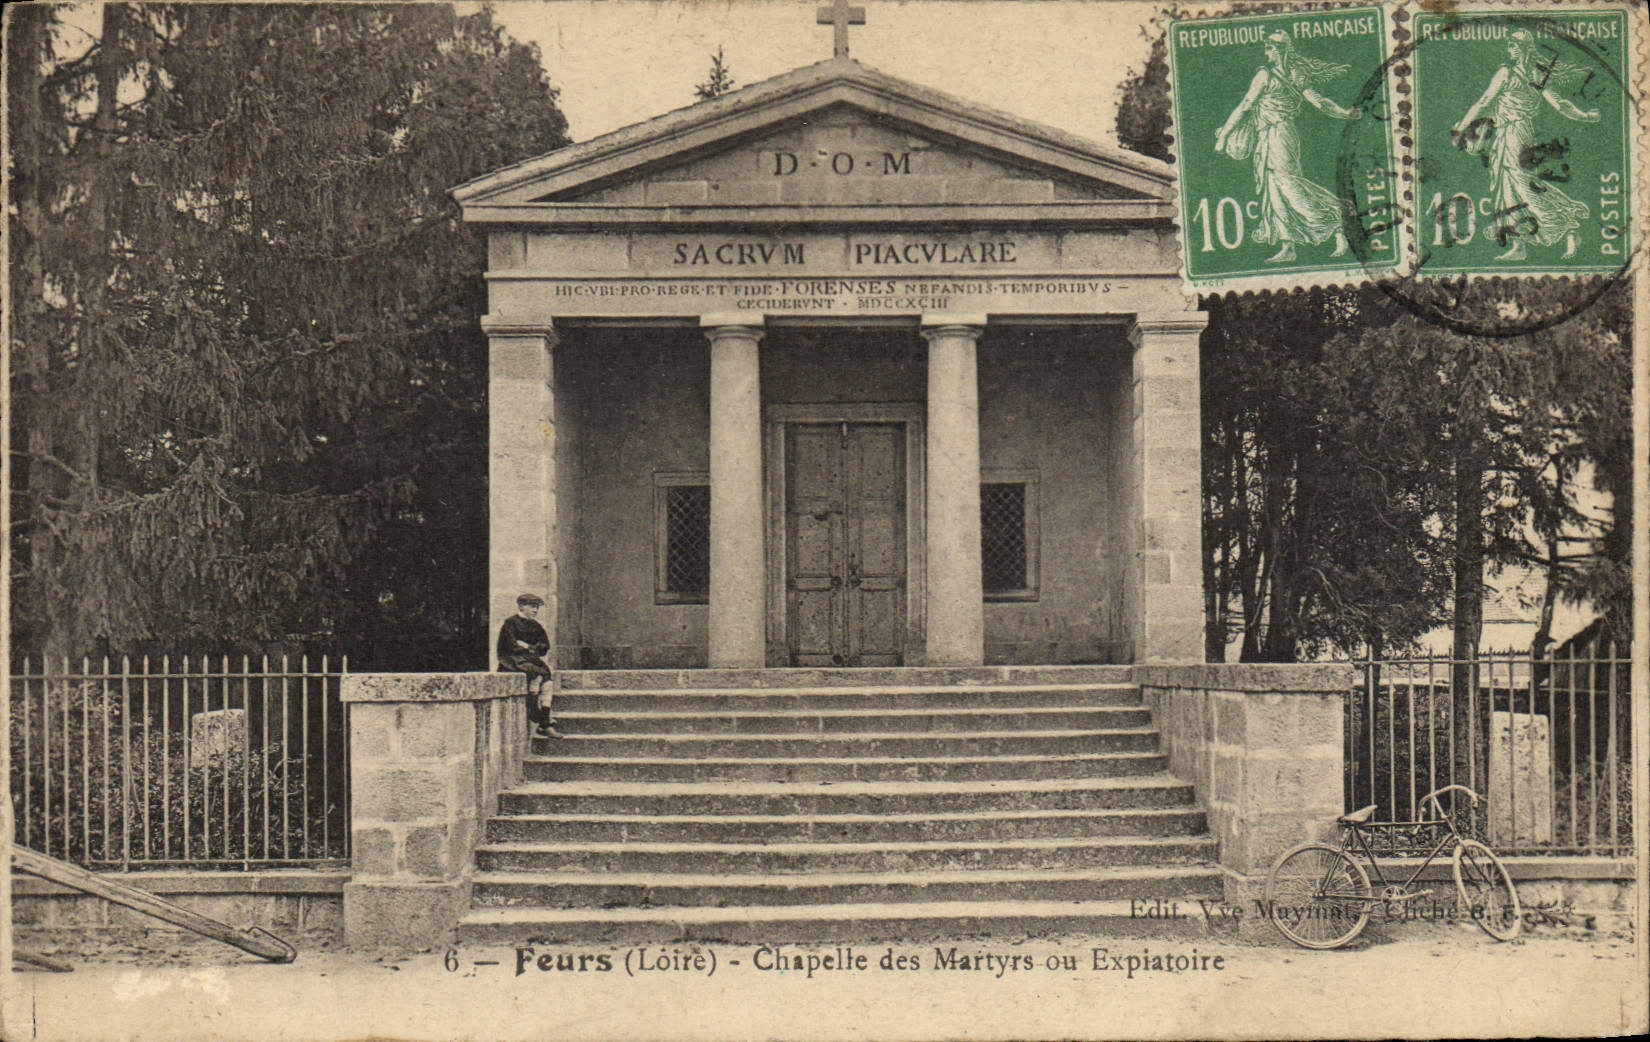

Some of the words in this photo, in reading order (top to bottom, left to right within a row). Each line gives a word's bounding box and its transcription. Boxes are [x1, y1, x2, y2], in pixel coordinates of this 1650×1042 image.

[1292, 17, 1376, 40] FRANÇAISE
[1600, 171, 1620, 255] POSTES
[673, 242, 806, 266] SACRVM
[855, 241, 1017, 265] PIACVLARE
[733, 284, 773, 296] FIDE
[781, 280, 897, 296] FORENSES
[736, 298, 835, 310] CECIDERVNT
